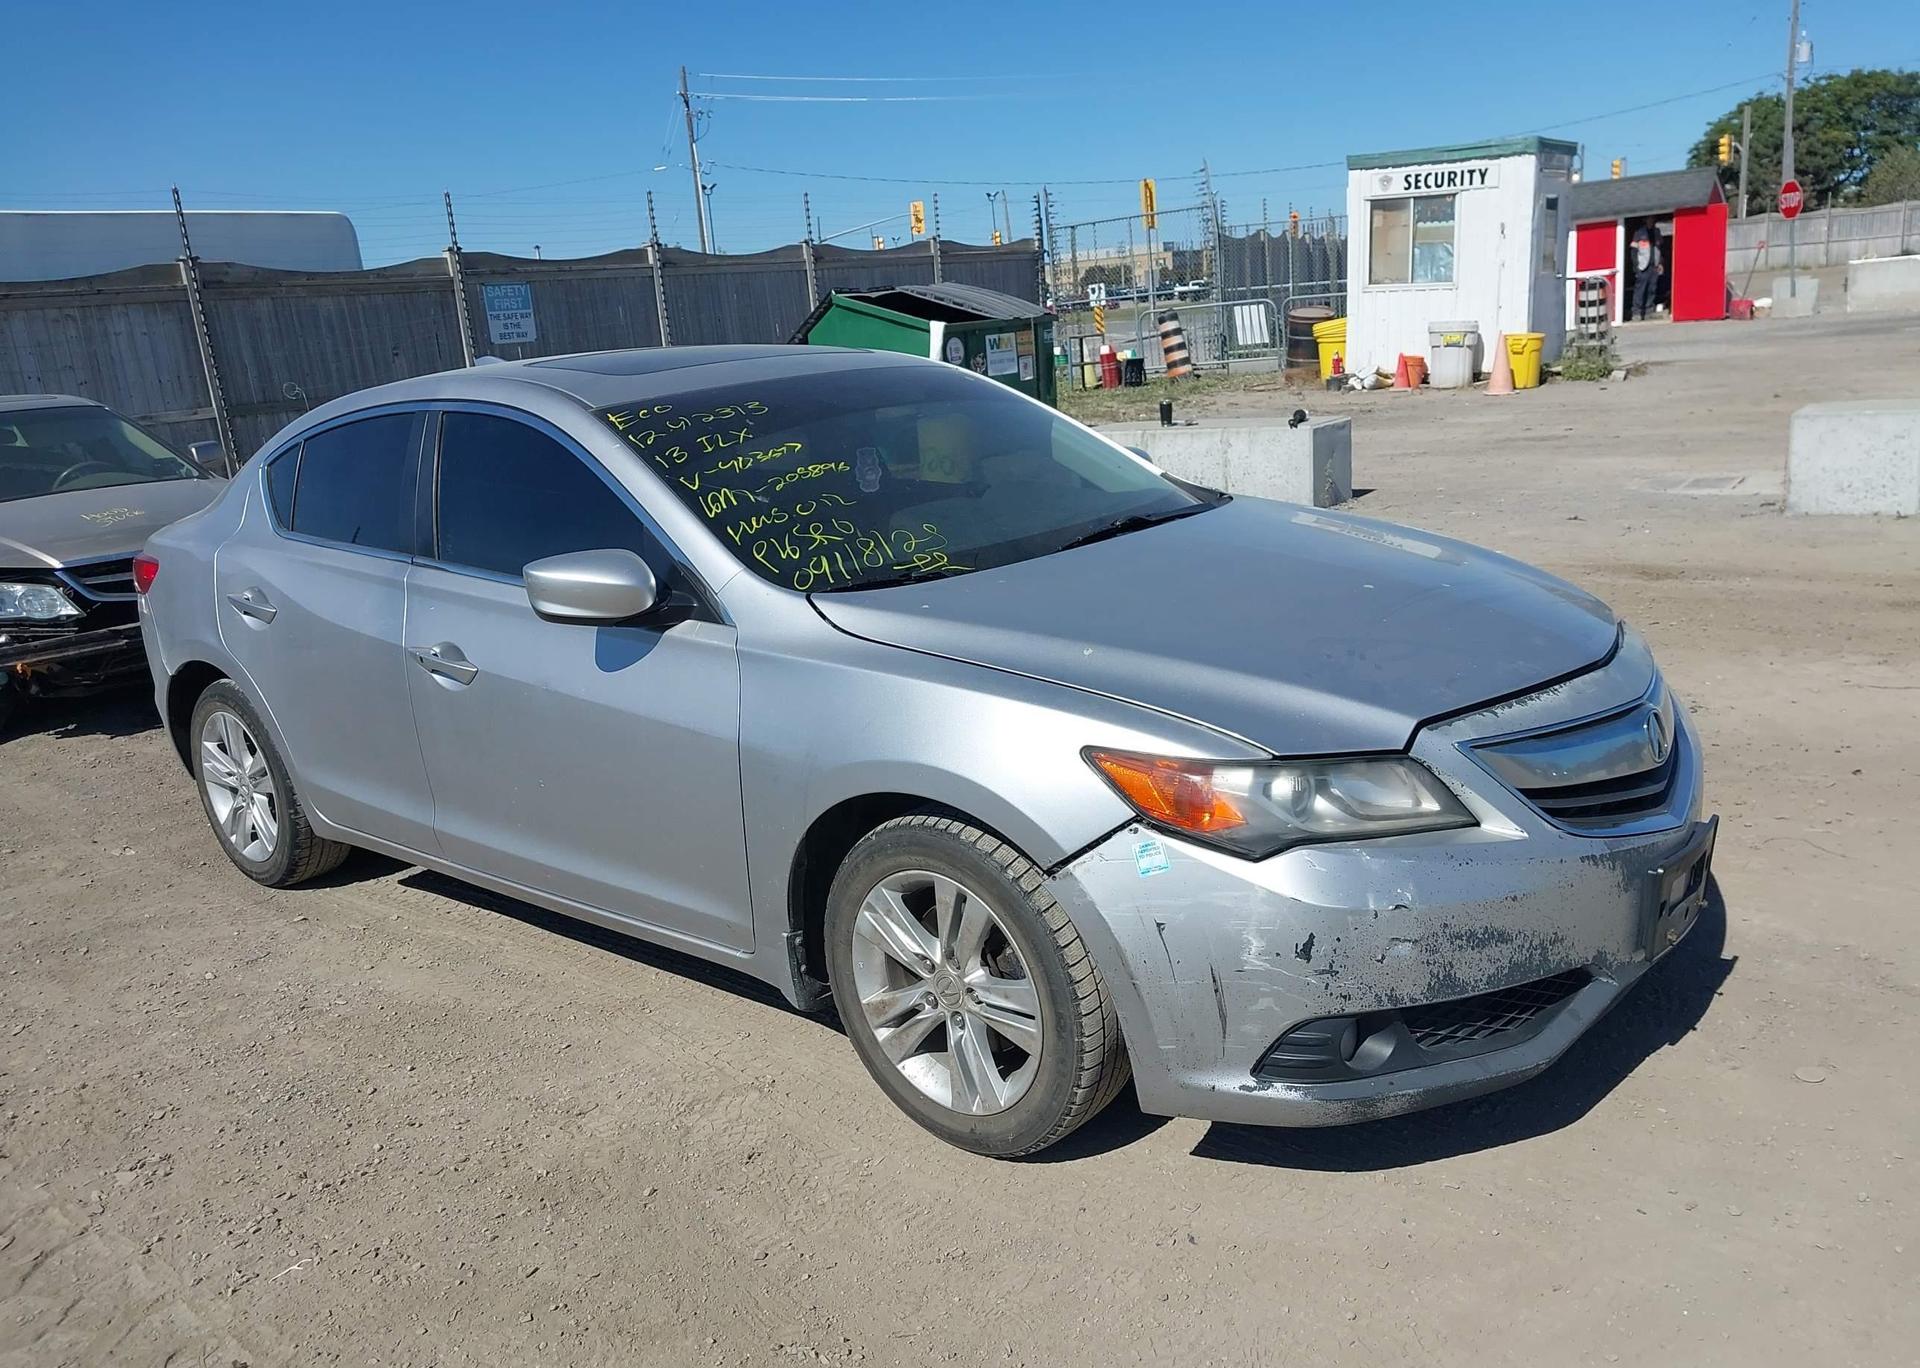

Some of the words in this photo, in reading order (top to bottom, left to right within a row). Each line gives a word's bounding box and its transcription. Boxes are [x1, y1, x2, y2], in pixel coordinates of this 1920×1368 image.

[1403, 167, 1489, 191] SECURITY
[1781, 191, 1801, 209] STOP
[487, 284, 527, 297] SAFETY
[495, 297, 523, 310] FIRST
[655, 446, 688, 469] 13
[696, 428, 753, 453] ILX
